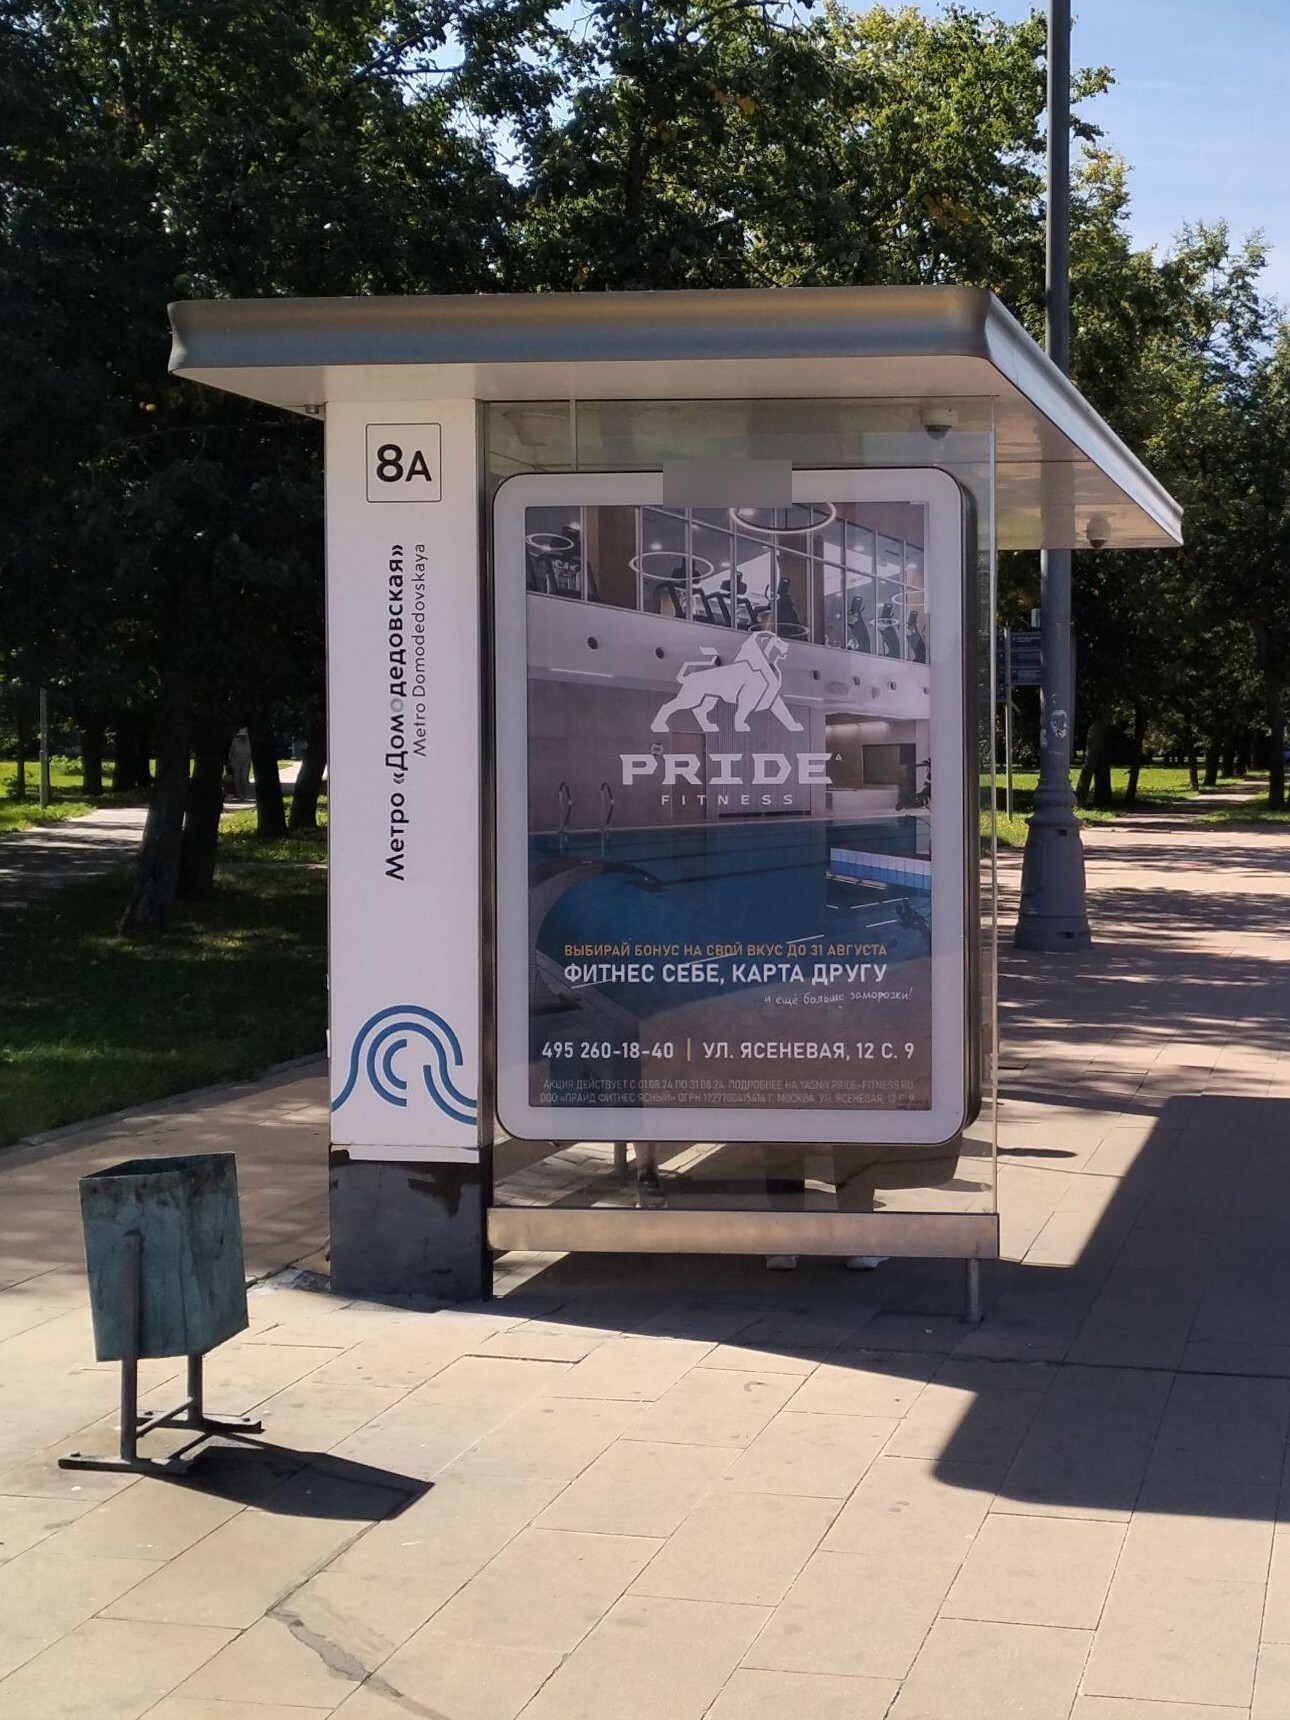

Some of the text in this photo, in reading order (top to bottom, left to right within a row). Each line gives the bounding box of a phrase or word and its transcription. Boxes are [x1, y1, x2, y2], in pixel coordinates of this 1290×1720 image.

[376, 443, 433, 483] 8А
[411, 544, 428, 757] Metro Domodedovskaya
[385, 544, 409, 881] Метро «Домодедовская»
[619, 753, 833, 785] PRIDE
[661, 794, 793, 806] FITNESS
[564, 941, 887, 958] ВЫБИРАЙ БОНУС НА СВОЙ ВКУС ДО 31 АВГУСТА
[564, 963, 888, 986] ФИТНЕС СЕБЕ, КАРТА ДРУГУ
[541, 1041, 915, 1061] 495 260-18-40 УЛ. ЯСЕНЕВАЯ, 12 С. 9
